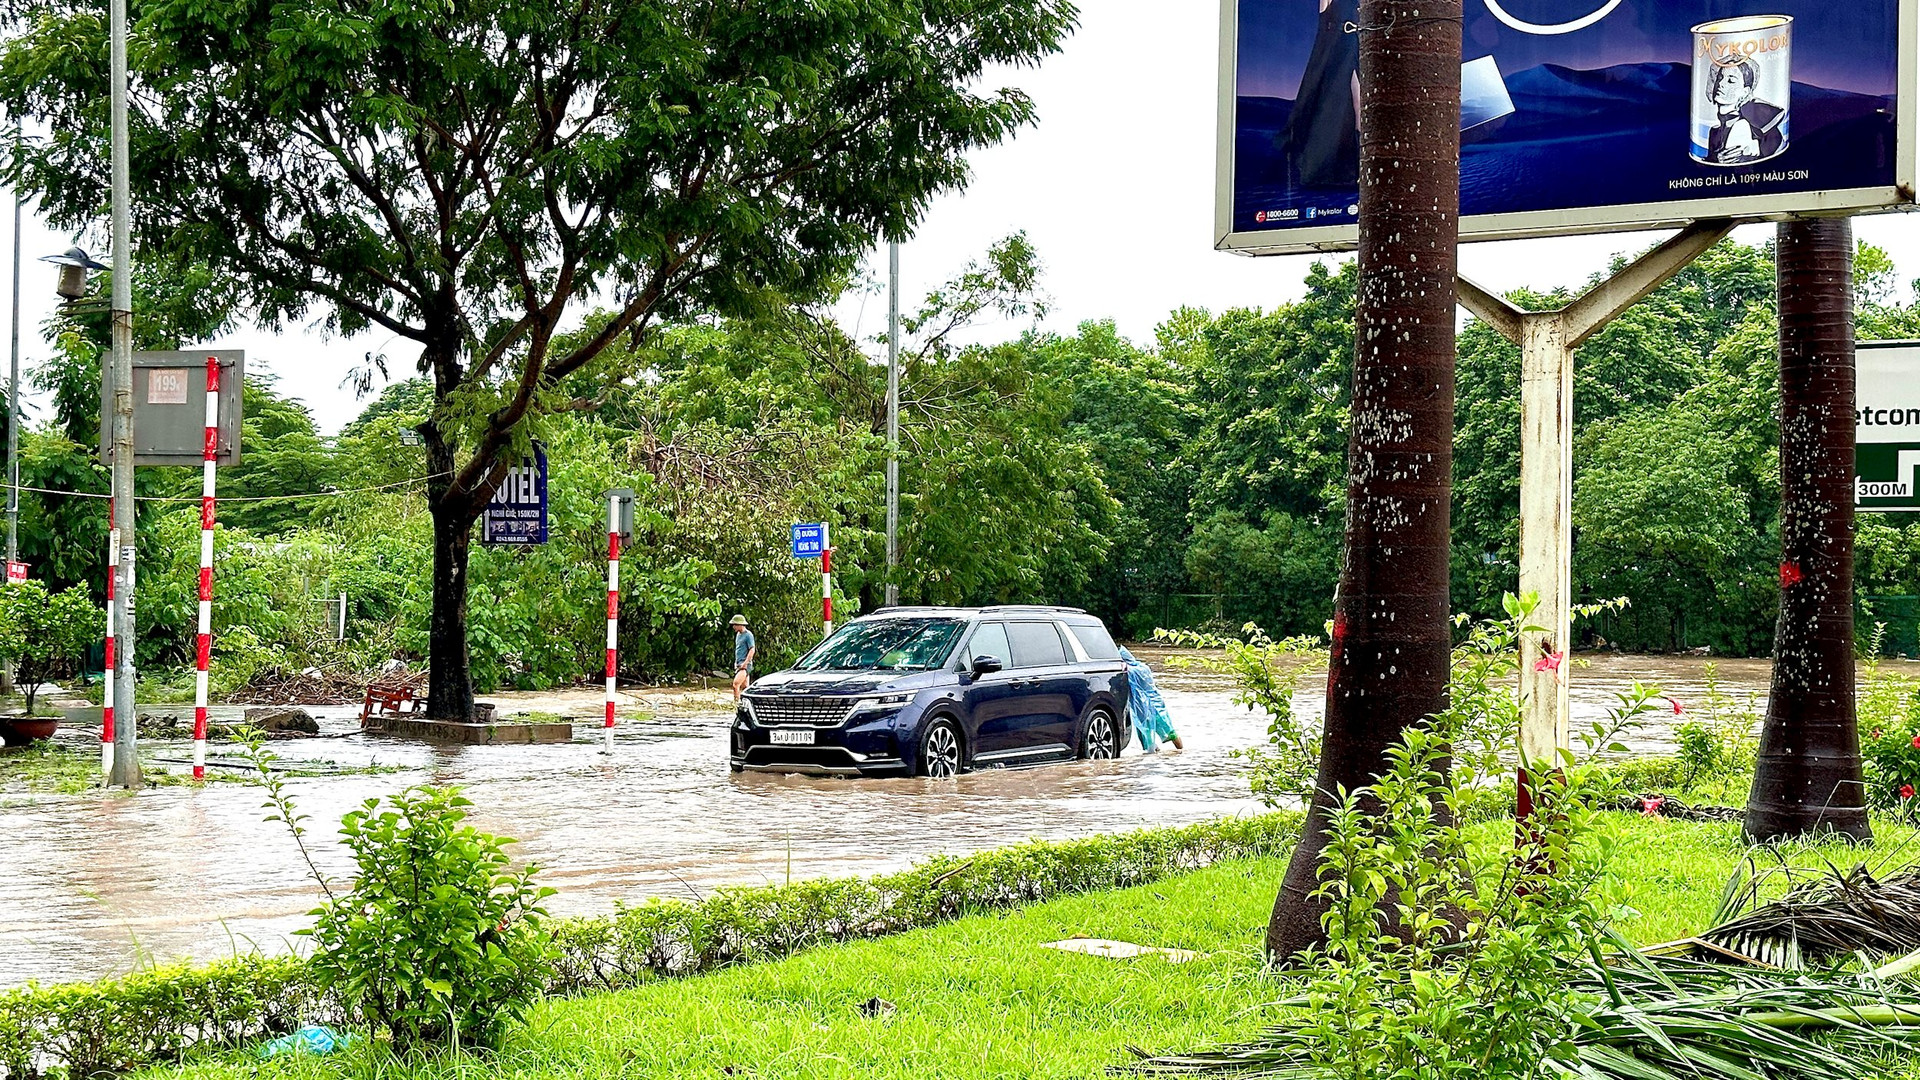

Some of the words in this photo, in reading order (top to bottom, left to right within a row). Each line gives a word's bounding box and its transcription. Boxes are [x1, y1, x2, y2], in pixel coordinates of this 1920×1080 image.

[1698, 34, 1788, 67] MYKOLOR
[1669, 177, 1704, 189] KHÔNG
[1705, 174, 1722, 187] CHỈ
[1724, 173, 1737, 185] LÀ
[1740, 173, 1760, 184] 1099
[1763, 170, 1786, 182] MÀU
[1787, 169, 1809, 180] SƠN
[1317, 208, 1342, 216] Mykolor
[491, 467, 539, 503] OTEL
[1858, 483, 1908, 496] 300M
